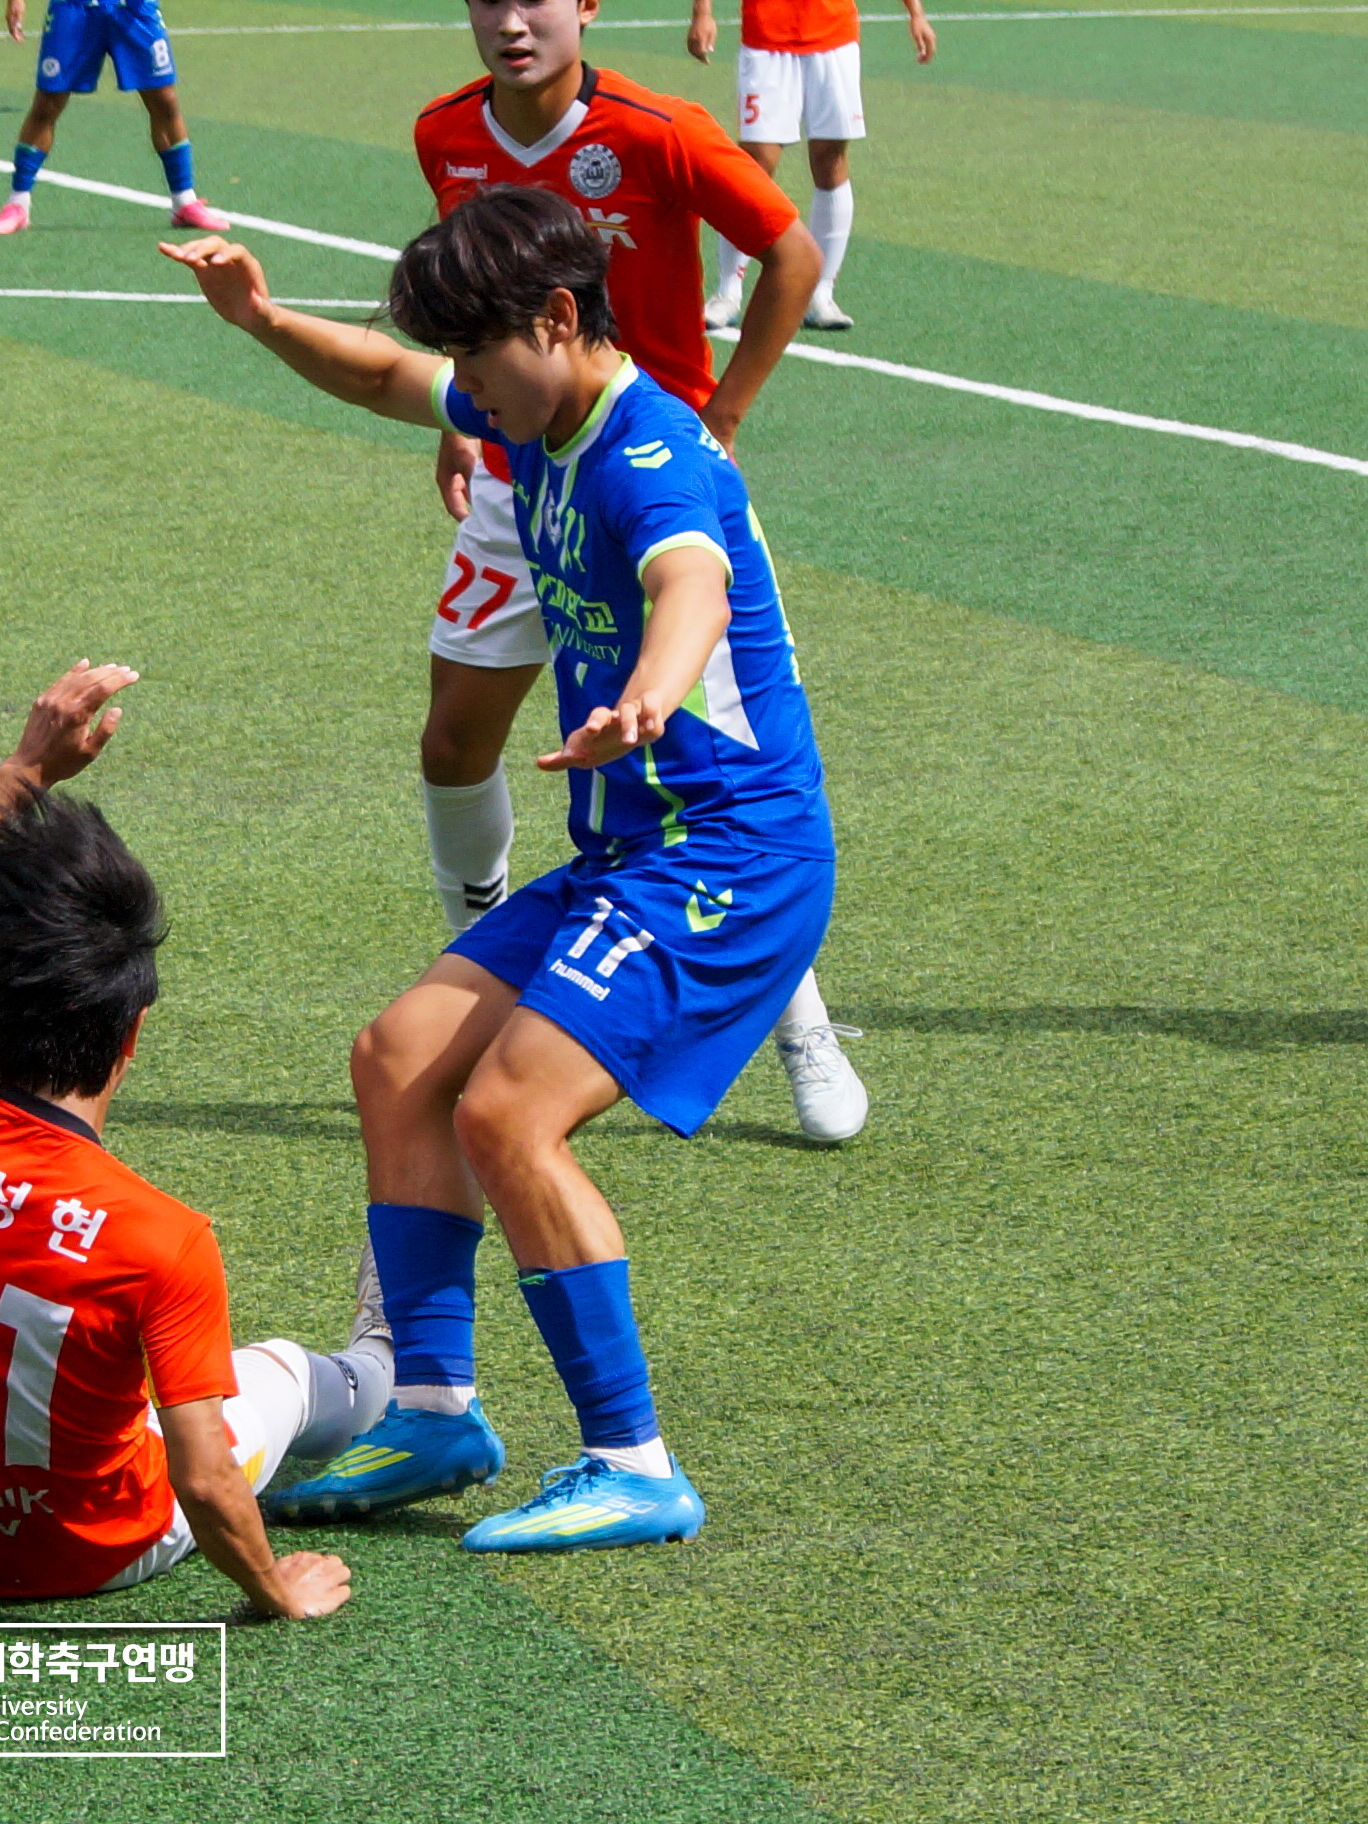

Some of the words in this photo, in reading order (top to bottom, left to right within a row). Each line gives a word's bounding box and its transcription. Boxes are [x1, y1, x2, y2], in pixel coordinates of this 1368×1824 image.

[152, 39, 169, 67] 8
[744, 93, 759, 124] 5
[436, 551, 519, 630] 27
[567, 896, 656, 978] 17
[548, 957, 612, 1002] hummel
